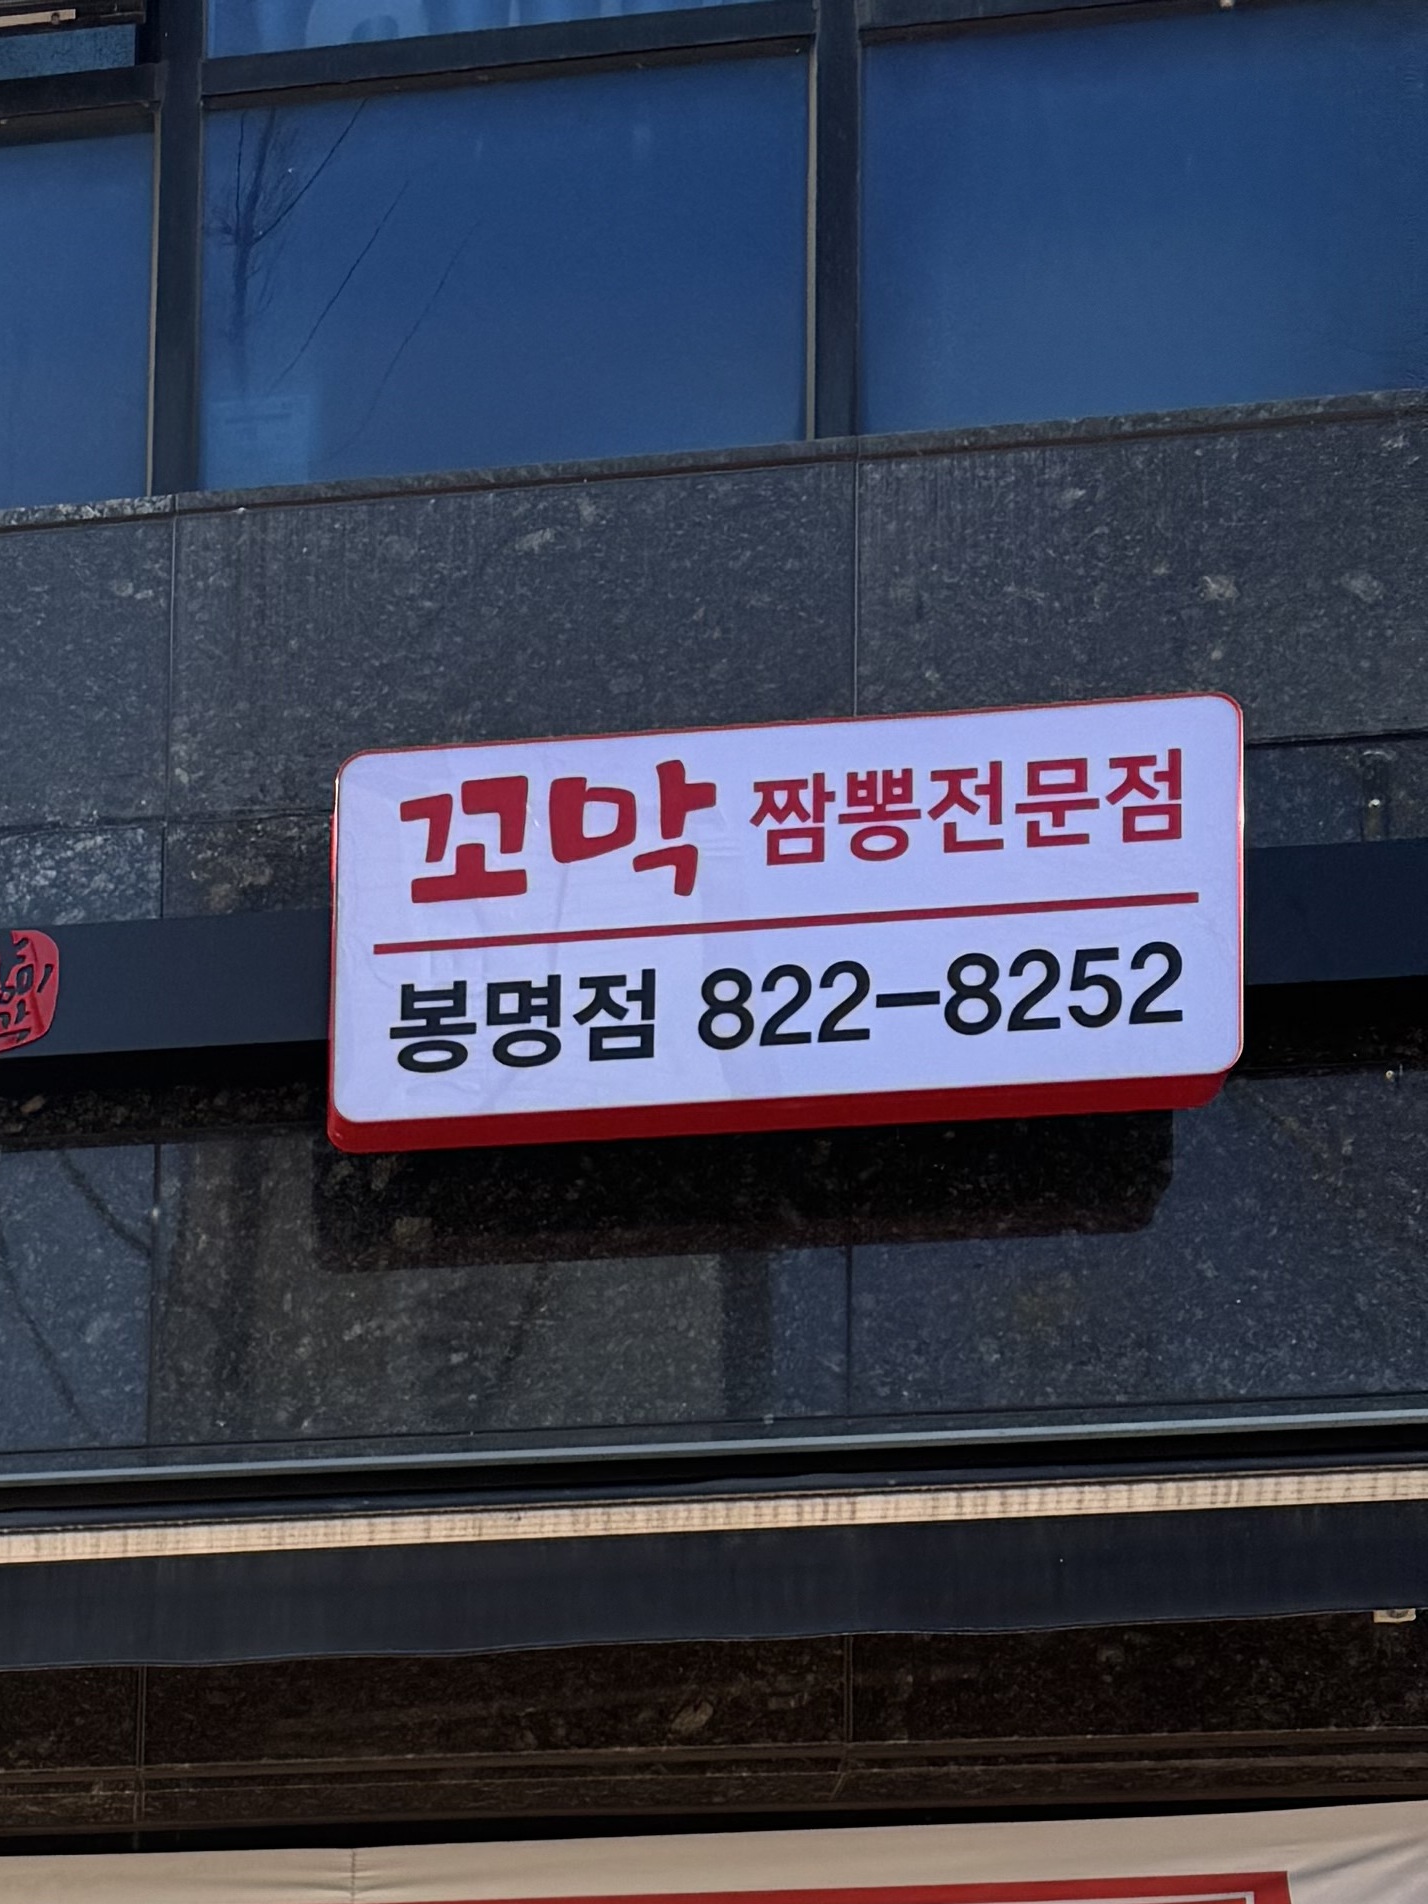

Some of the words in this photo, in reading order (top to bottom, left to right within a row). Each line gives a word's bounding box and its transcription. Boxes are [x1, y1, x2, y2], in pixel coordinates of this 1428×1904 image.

[400, 760, 716, 903] 꼬막
[751, 748, 1183, 864] 짬뽕전문점
[388, 968, 657, 1074] 봉명점
[696, 941, 1184, 1051] 822-8252
